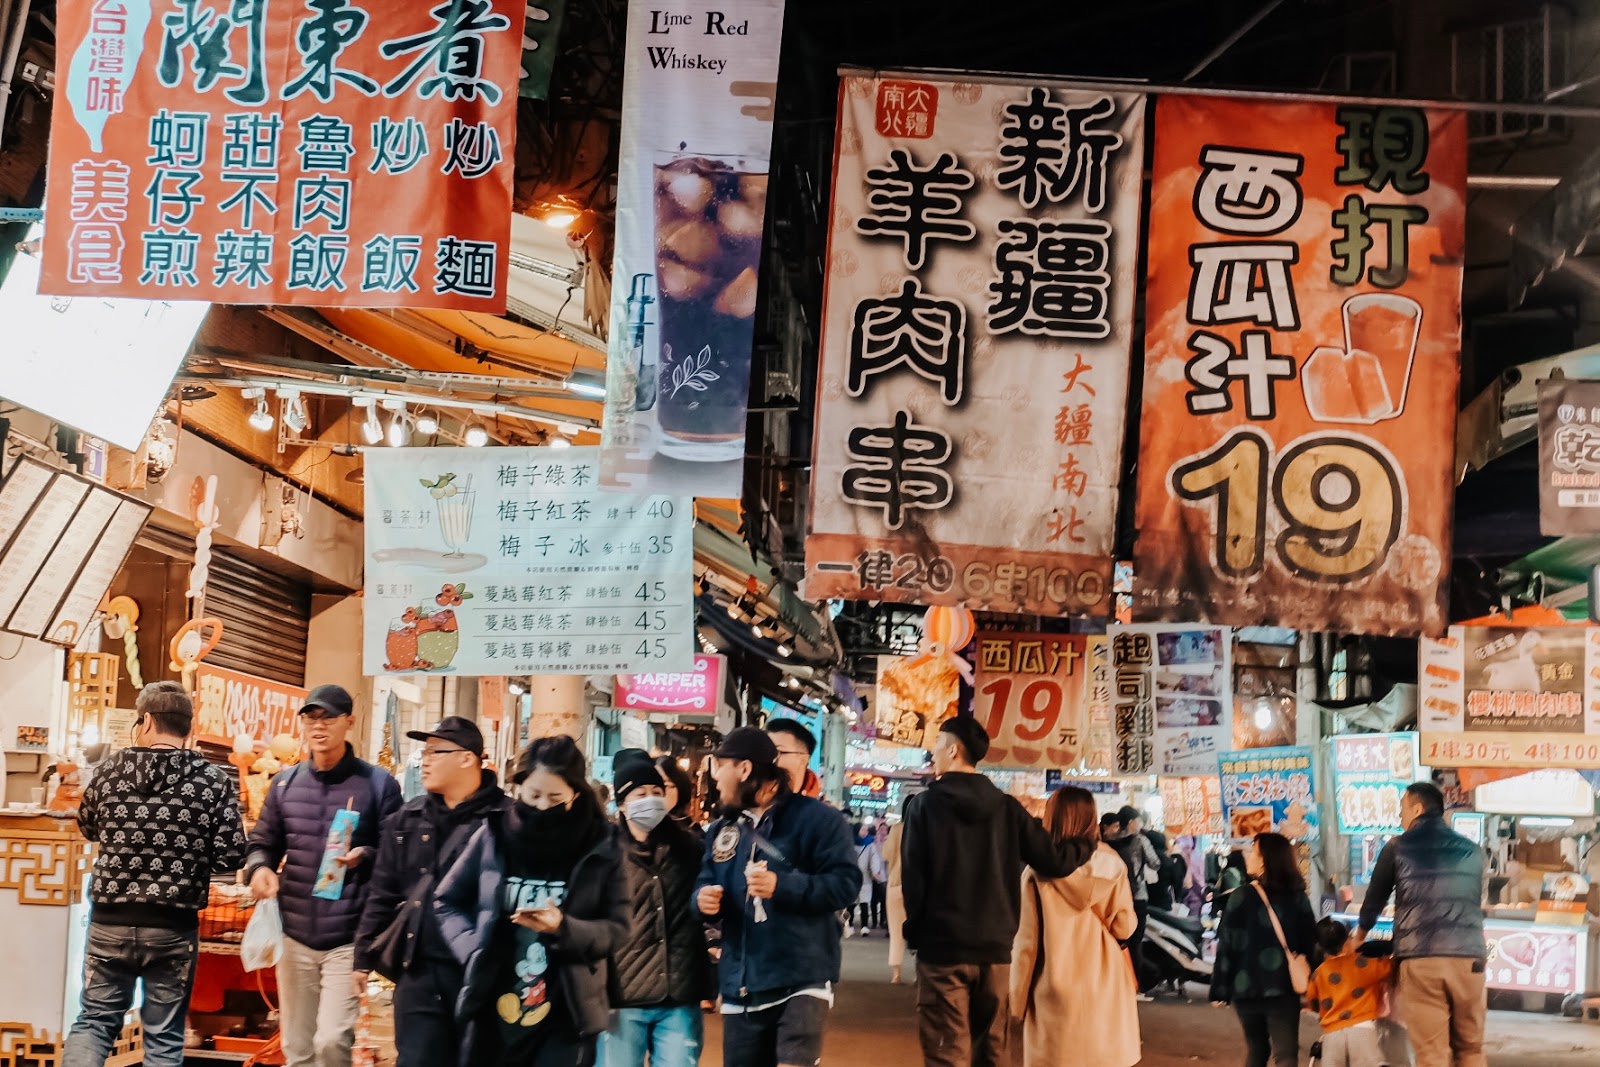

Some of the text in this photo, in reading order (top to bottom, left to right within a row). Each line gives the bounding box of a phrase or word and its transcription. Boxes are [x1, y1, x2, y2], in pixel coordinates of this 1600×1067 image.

[86, 0, 128, 113] 台灣味
[647, 10, 749, 36] Lime Red
[647, 46, 728, 75] Whiskey
[67, 159, 131, 285] 美食
[138, 110, 207, 289] 蚵仔煎
[212, 112, 281, 290] 甜不辣
[287, 115, 354, 293] 魯肉飯
[988, 86, 1124, 338] 新疆
[1329, 104, 1430, 288] 現打
[843, 149, 977, 531] 羊肉串
[1183, 144, 1304, 421] 西瓜汁
[497, 464, 591, 488] 梅子綠茶
[1046, 353, 1096, 544] 大疆南北
[1165, 424, 1410, 584] 19
[497, 499, 592, 523] 梅子紅茶
[647, 500, 674, 519] 40
[498, 534, 592, 558] 梅子冰
[648, 535, 673, 554] 35
[484, 585, 574, 603] 蔓越莓紅茶
[634, 581, 667, 602] 45
[484, 614, 574, 632] 蔓越莓綠茶
[634, 610, 667, 631] 45
[634, 638, 667, 659] 45
[981, 638, 1082, 676] 西瓜汁
[981, 678, 1077, 746] 19 元
[1112, 631, 1154, 774] 起司雞排
